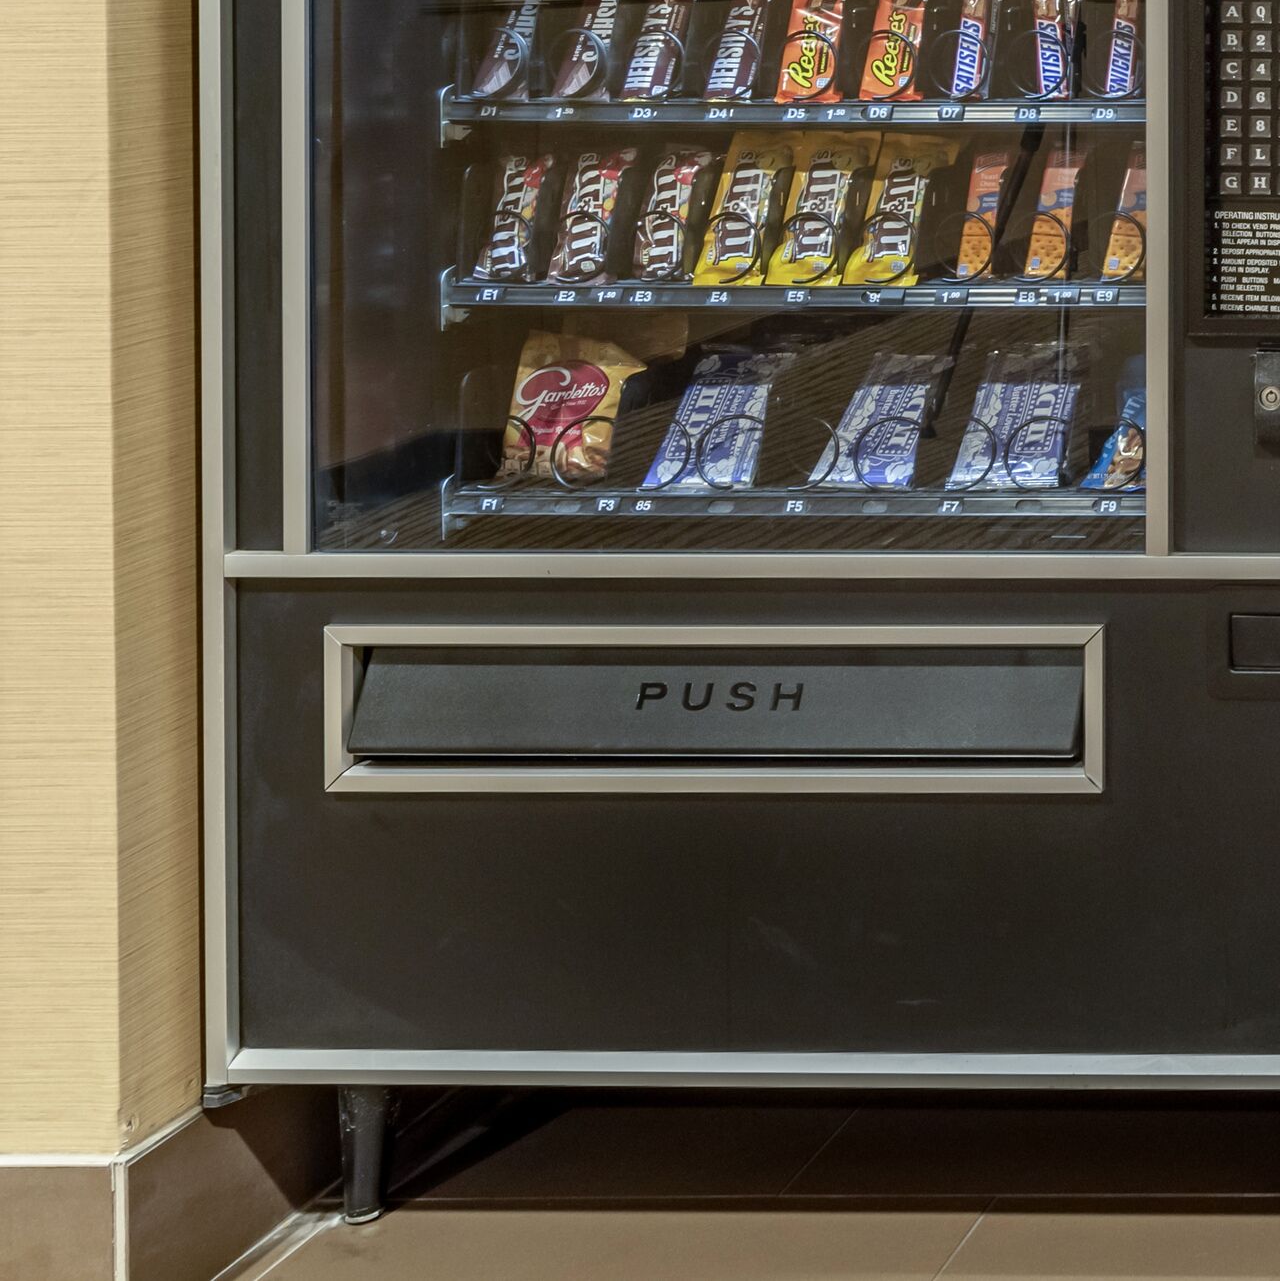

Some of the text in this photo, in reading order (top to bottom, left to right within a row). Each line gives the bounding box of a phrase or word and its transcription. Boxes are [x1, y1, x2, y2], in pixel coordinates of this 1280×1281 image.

[1225, 5, 1239, 17] A
[1256, 5, 1265, 18] 0
[1226, 33, 1238, 46] B
[1256, 34, 1266, 46] 2
[871, 10, 908, 89] Reese's
[954, 20, 980, 94] SATISFIS
[1038, 21, 1063, 95] SATISFIS
[1226, 62, 1239, 74] C
[1255, 63, 1266, 74] 4
[1226, 91, 1239, 103] D
[1255, 91, 1265, 103] 6
[481, 106, 497, 117] D1
[633, 107, 651, 118] D3
[709, 107, 727, 118] D4
[787, 108, 805, 119] D5
[869, 107, 888, 118] D6
[942, 107, 961, 118] D7
[1018, 108, 1037, 119] D8
[1096, 108, 1114, 119] D9
[1225, 119, 1238, 131] E
[1255, 120, 1265, 132] 8
[1226, 148, 1238, 160] F
[1255, 148, 1266, 160] L
[1225, 176, 1238, 188] G
[1253, 176, 1267, 189] H
[1214, 211, 1254, 220] OPERATING
[483, 289, 499, 301] E1
[558, 291, 575, 302] E2
[635, 291, 652, 302] E3
[710, 291, 728, 303] E4
[787, 291, 804, 303] E5
[1018, 291, 1036, 303] E8
[1097, 290, 1113, 302] E9
[482, 499, 498, 511] F1
[597, 499, 615, 511] F3
[635, 499, 652, 511] 85
[785, 500, 803, 512] F5
[942, 500, 960, 512] F7
[1101, 500, 1117, 512] F9
[634, 681, 804, 712] PUSH
